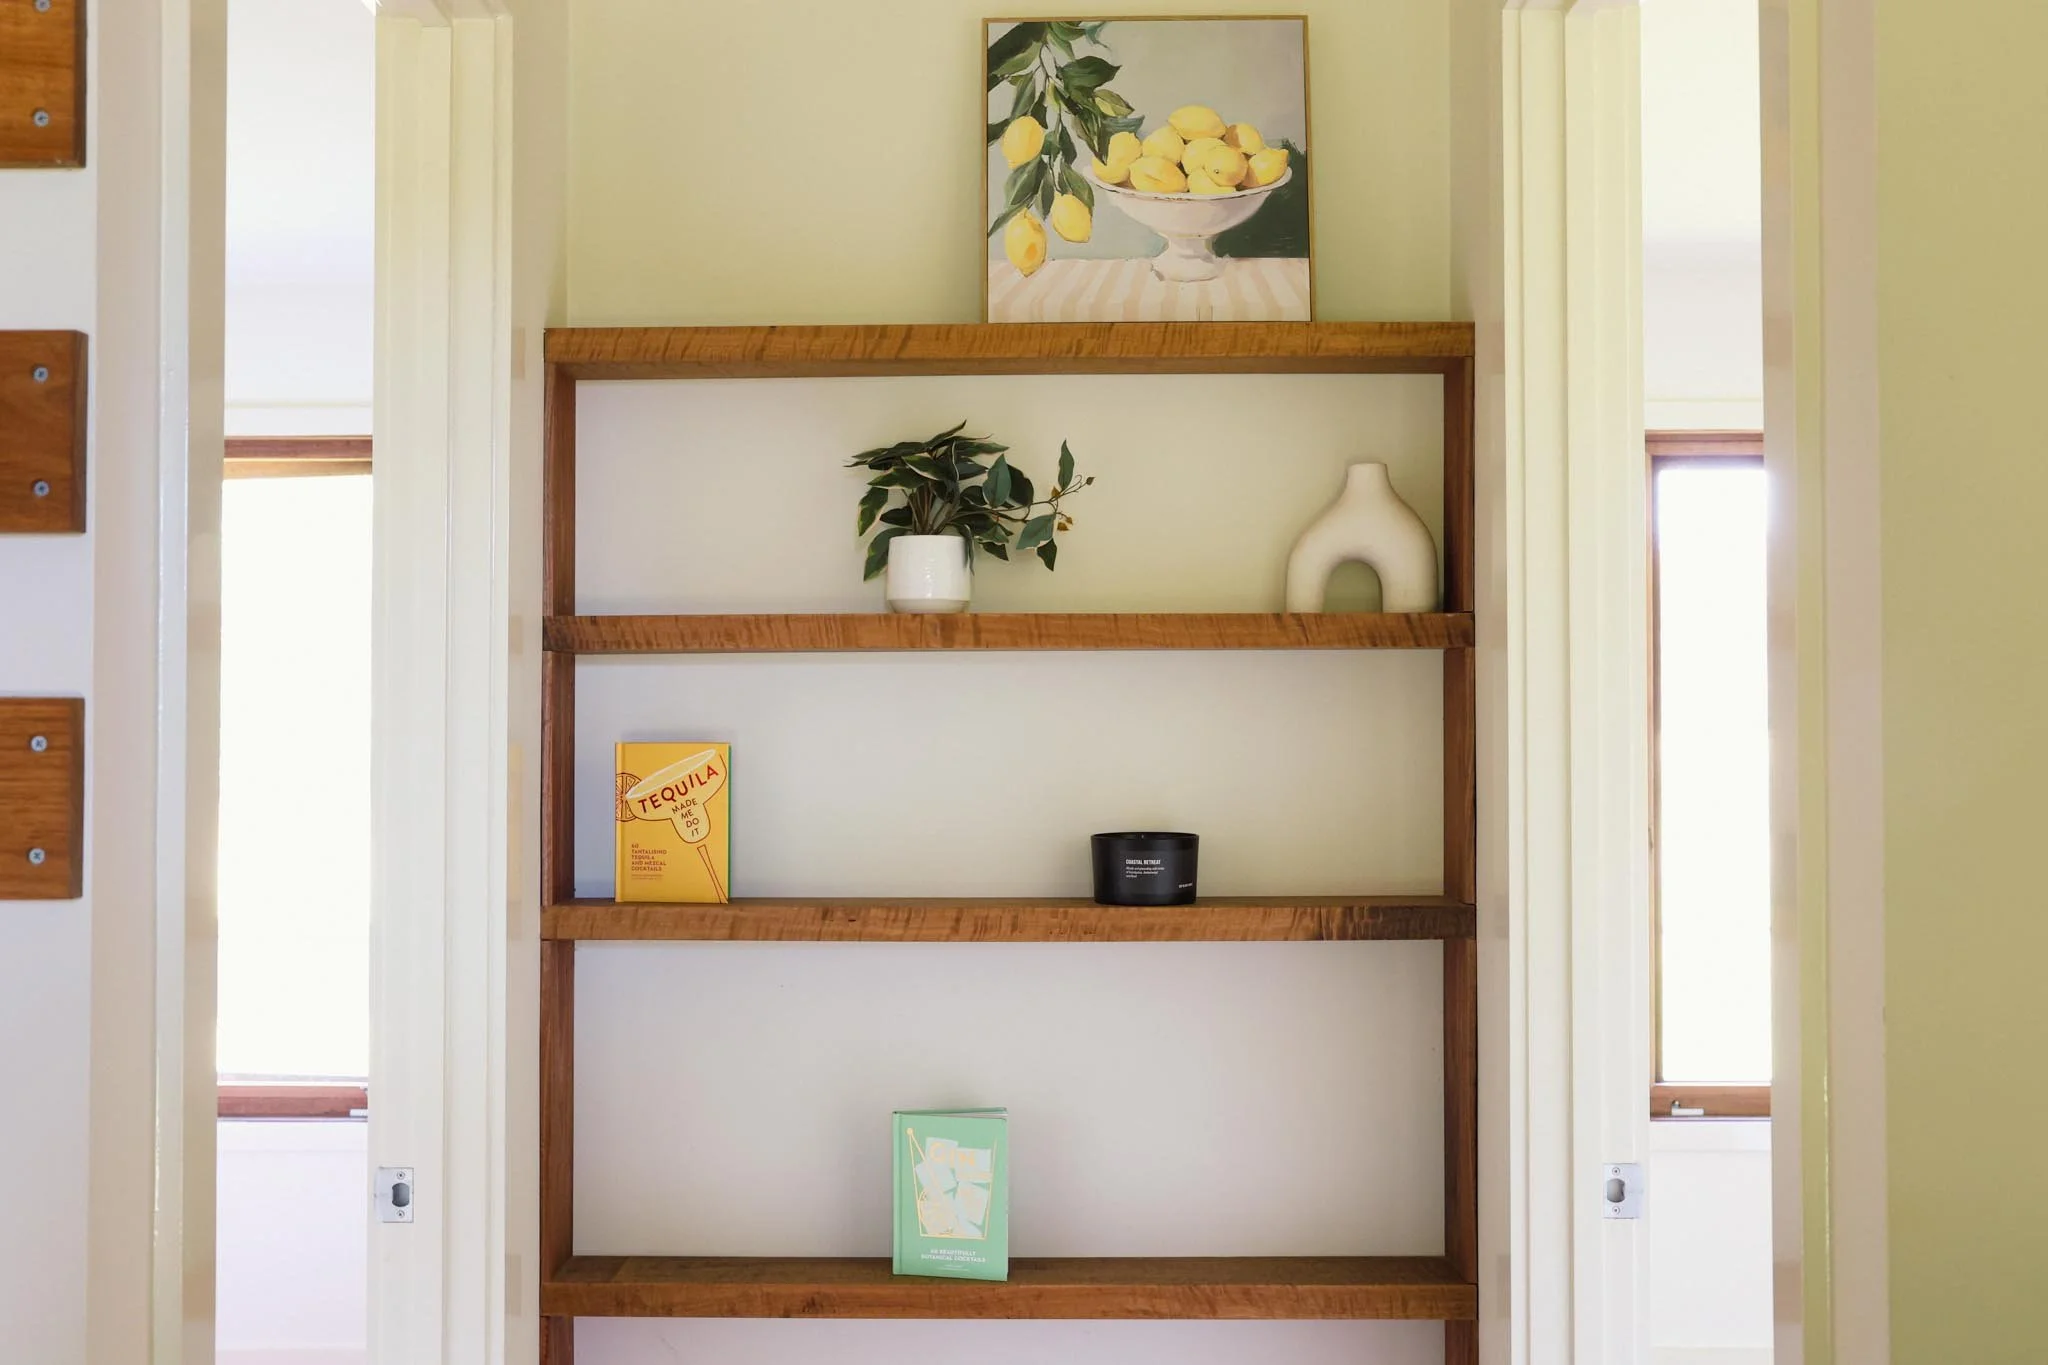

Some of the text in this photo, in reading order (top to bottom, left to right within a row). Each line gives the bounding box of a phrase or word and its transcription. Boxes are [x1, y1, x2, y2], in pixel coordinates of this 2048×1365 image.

[637, 764, 719, 813] TEQUILA
[671, 798, 698, 815] MADE
[681, 809, 694, 820] ME
[685, 817, 700, 828] DO
[691, 828, 700, 838] IT
[929, 1141, 976, 1168] GIN
[921, 1253, 986, 1263] BOTANICAL COCKTAILS
